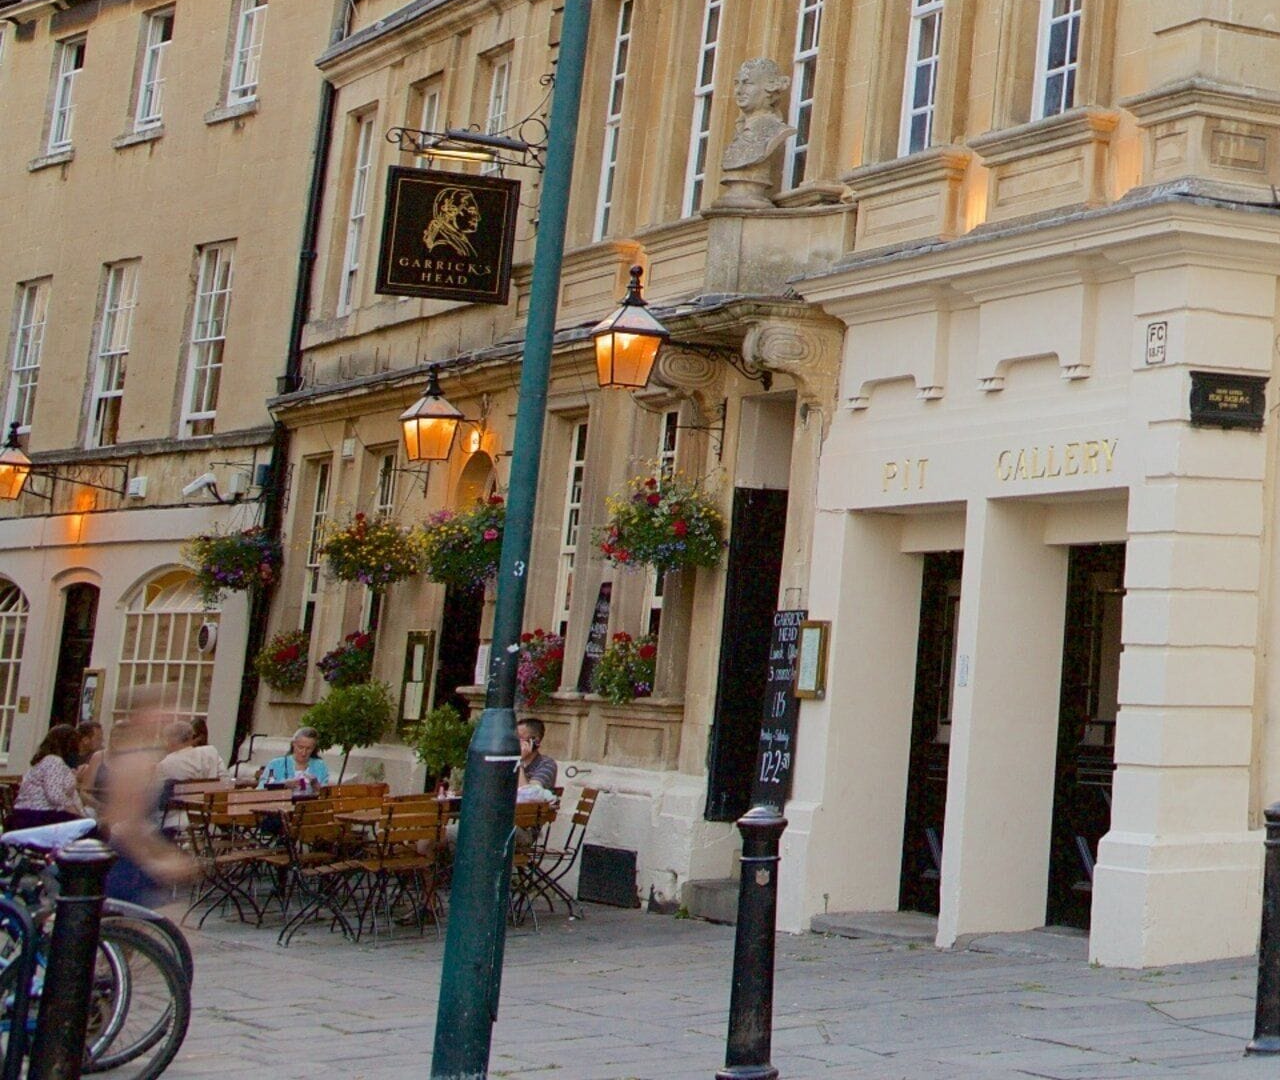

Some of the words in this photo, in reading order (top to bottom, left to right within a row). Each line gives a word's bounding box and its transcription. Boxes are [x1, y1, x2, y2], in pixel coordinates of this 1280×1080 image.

[399, 257, 492, 275] GARRICK'S
[421, 272, 468, 285] HEAD
[1149, 326, 1165, 342] FC
[882, 458, 929, 492] PIT
[996, 438, 1119, 482] GALLERY
[513, 560, 525, 577] 3
